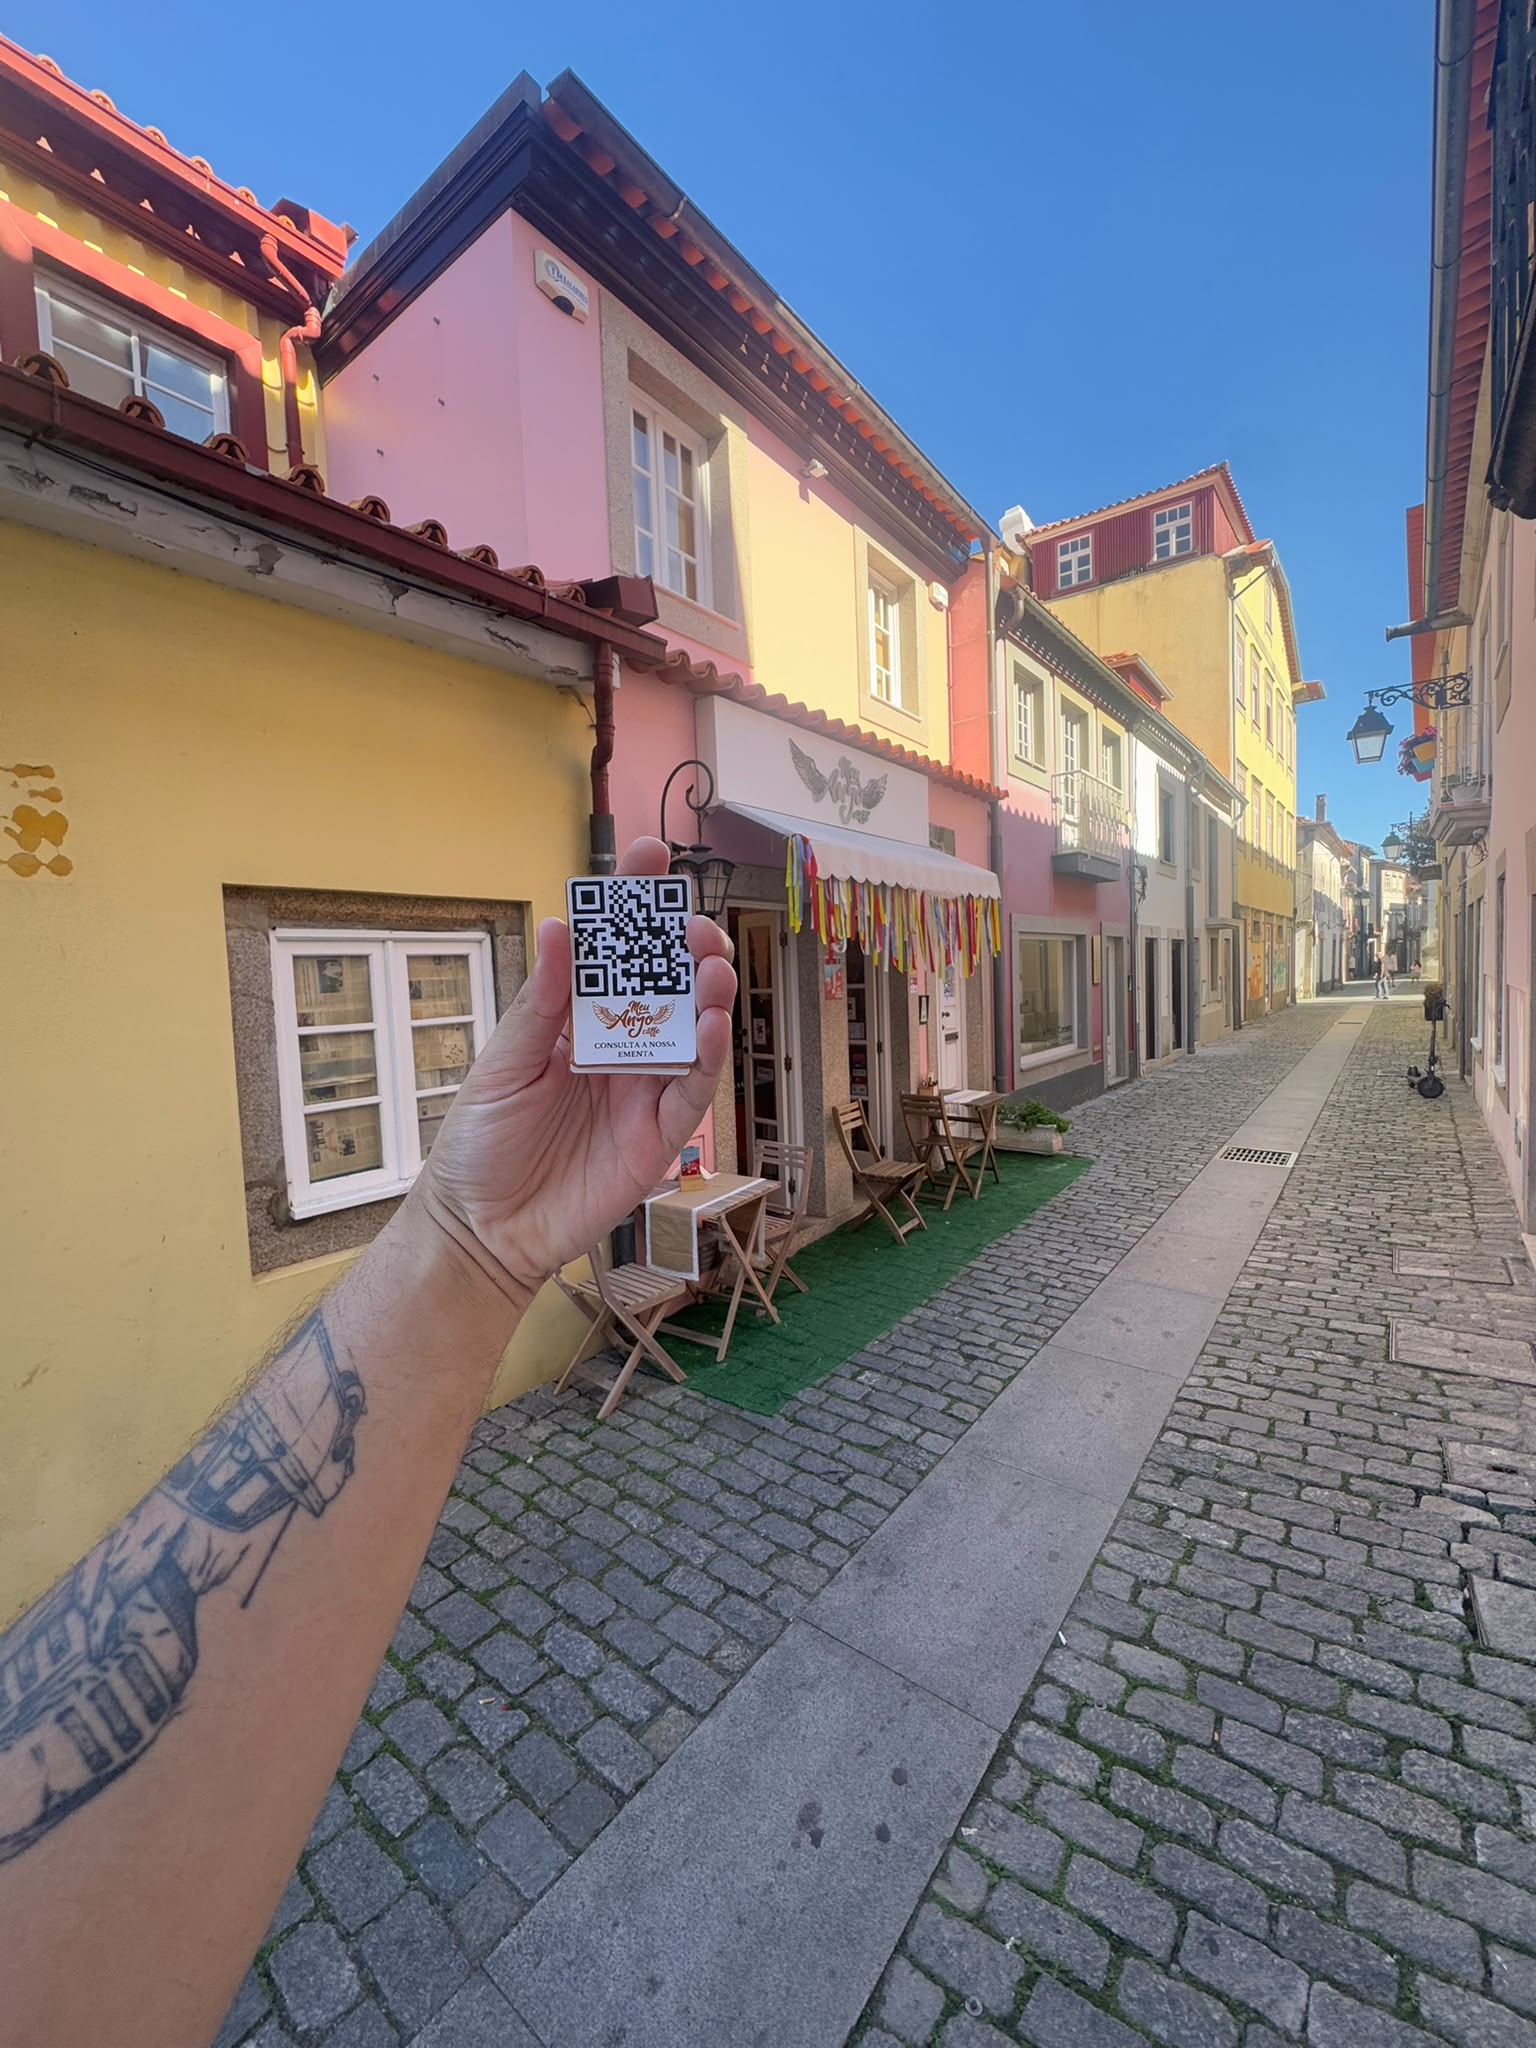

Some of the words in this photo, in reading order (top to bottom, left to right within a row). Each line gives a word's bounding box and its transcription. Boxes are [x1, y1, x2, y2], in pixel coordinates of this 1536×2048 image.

[628, 1000, 650, 1015] Meu
[594, 1041, 640, 1050] CONSULTA
[649, 1040, 677, 1048] NOSSA
[617, 1050, 655, 1058] EMENTA
